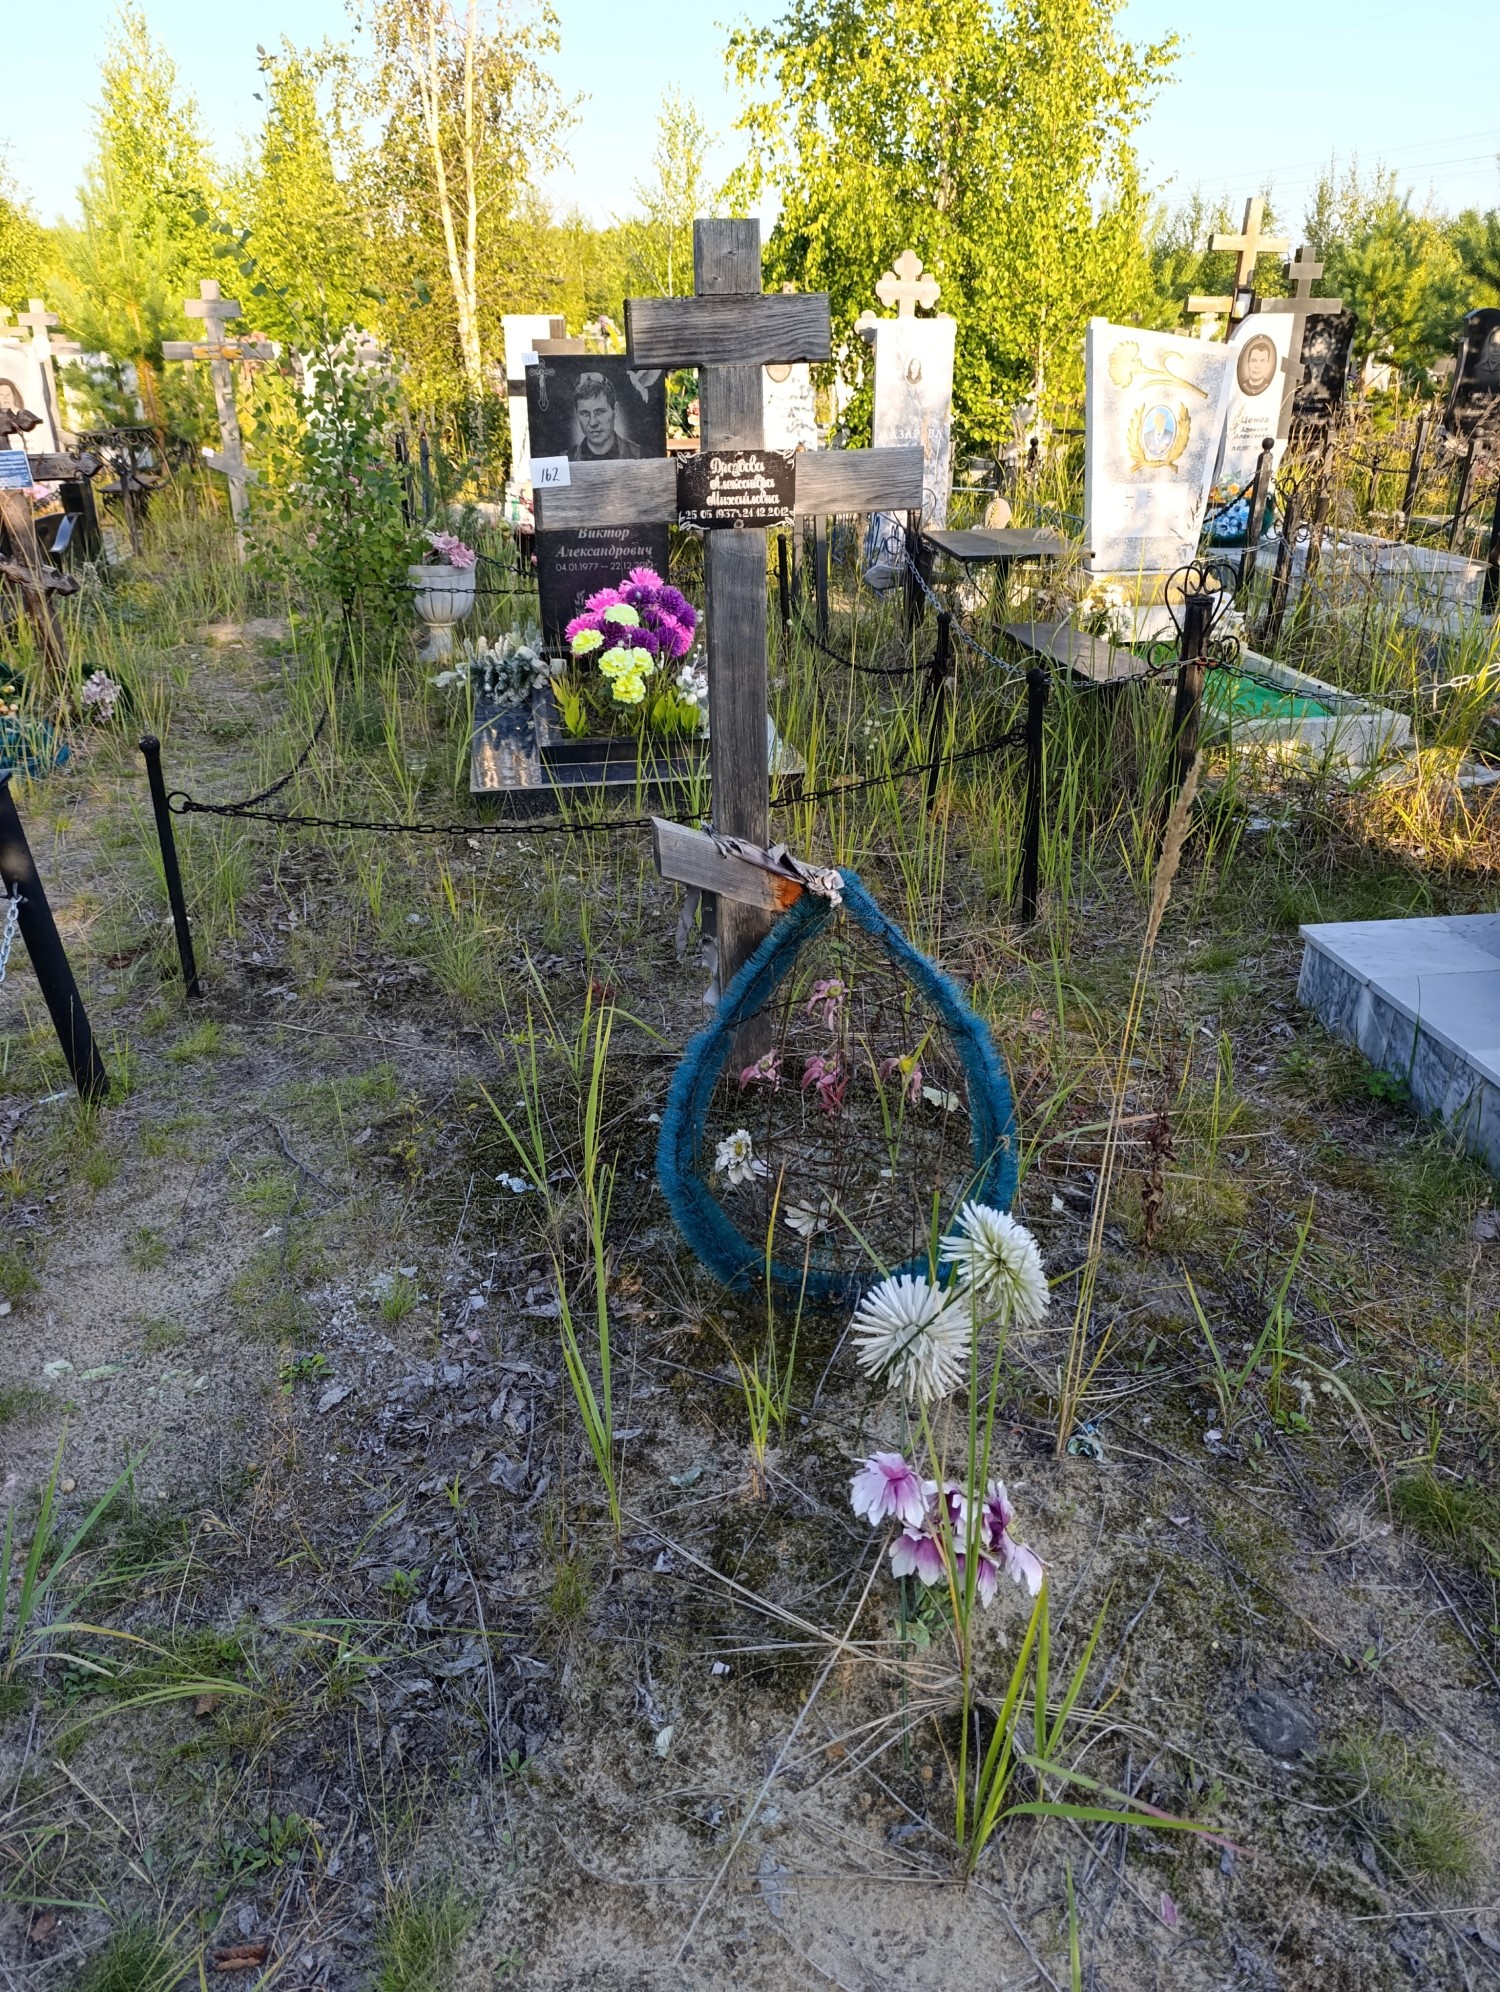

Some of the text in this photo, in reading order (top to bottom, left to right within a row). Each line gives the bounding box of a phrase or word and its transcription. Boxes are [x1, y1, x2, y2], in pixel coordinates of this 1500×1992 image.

[541, 466, 560, 483] 162
[709, 474, 776, 491] Александра
[706, 490, 780, 506] Михайловна
[577, 528, 630, 541] Виктор
[555, 545, 653, 559] Александрович
